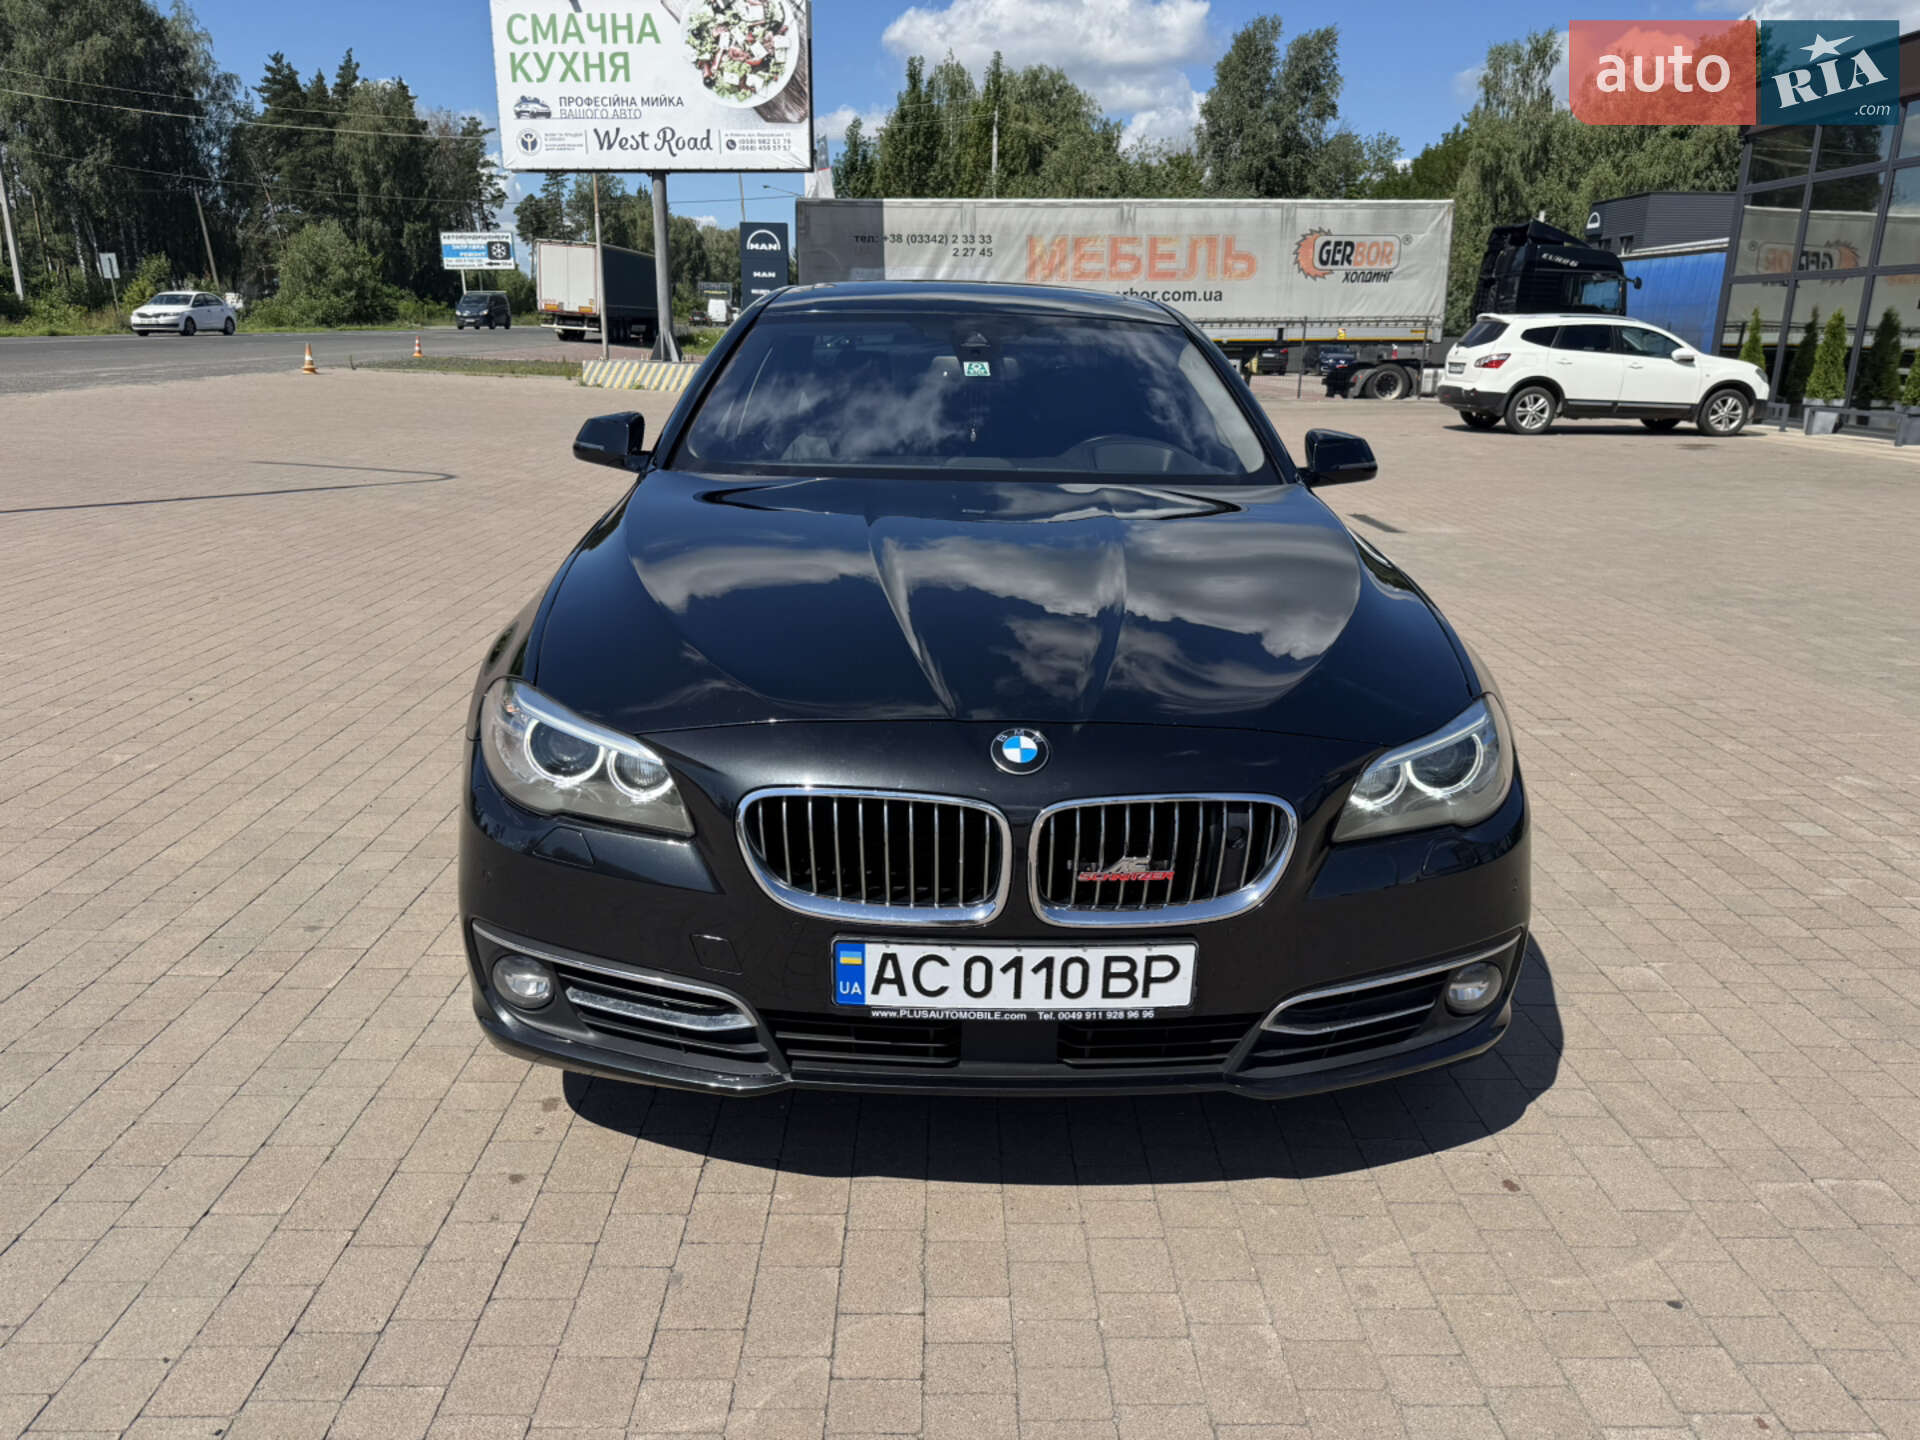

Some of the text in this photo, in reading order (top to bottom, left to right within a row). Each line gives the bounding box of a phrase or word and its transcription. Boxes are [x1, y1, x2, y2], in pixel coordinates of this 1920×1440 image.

[506, 13, 661, 44] СМАЧНА
[509, 52, 631, 83] КУХНЯ
[559, 94, 685, 108] ПРОФЕСІЙНА МИЙКА
[560, 109, 642, 119] ВАШОГО АВТО
[593, 127, 649, 151] West
[654, 126, 712, 157] Road
[883, 234, 903, 243] +38
[906, 234, 948, 245] (03342)
[951, 235, 958, 244] 2
[962, 235, 975, 244] 33
[979, 235, 992, 244] 33
[953, 248, 993, 257] 2 27 45
[1026, 234, 1257, 282] МЕБЕЛЬ
[1319, 240, 1394, 266] GERBOR
[871, 952, 1181, 1000] AC 0110 BP
[840, 982, 862, 995] UA
[871, 1009, 1027, 1020] www.PLUSAUTOMOBILE.com
[1038, 1011, 1055, 1020] Tel.
[1058, 1011, 1082, 1020] 0049
[1085, 1011, 1102, 1020] 911
[1106, 1011, 1124, 1019] 928
